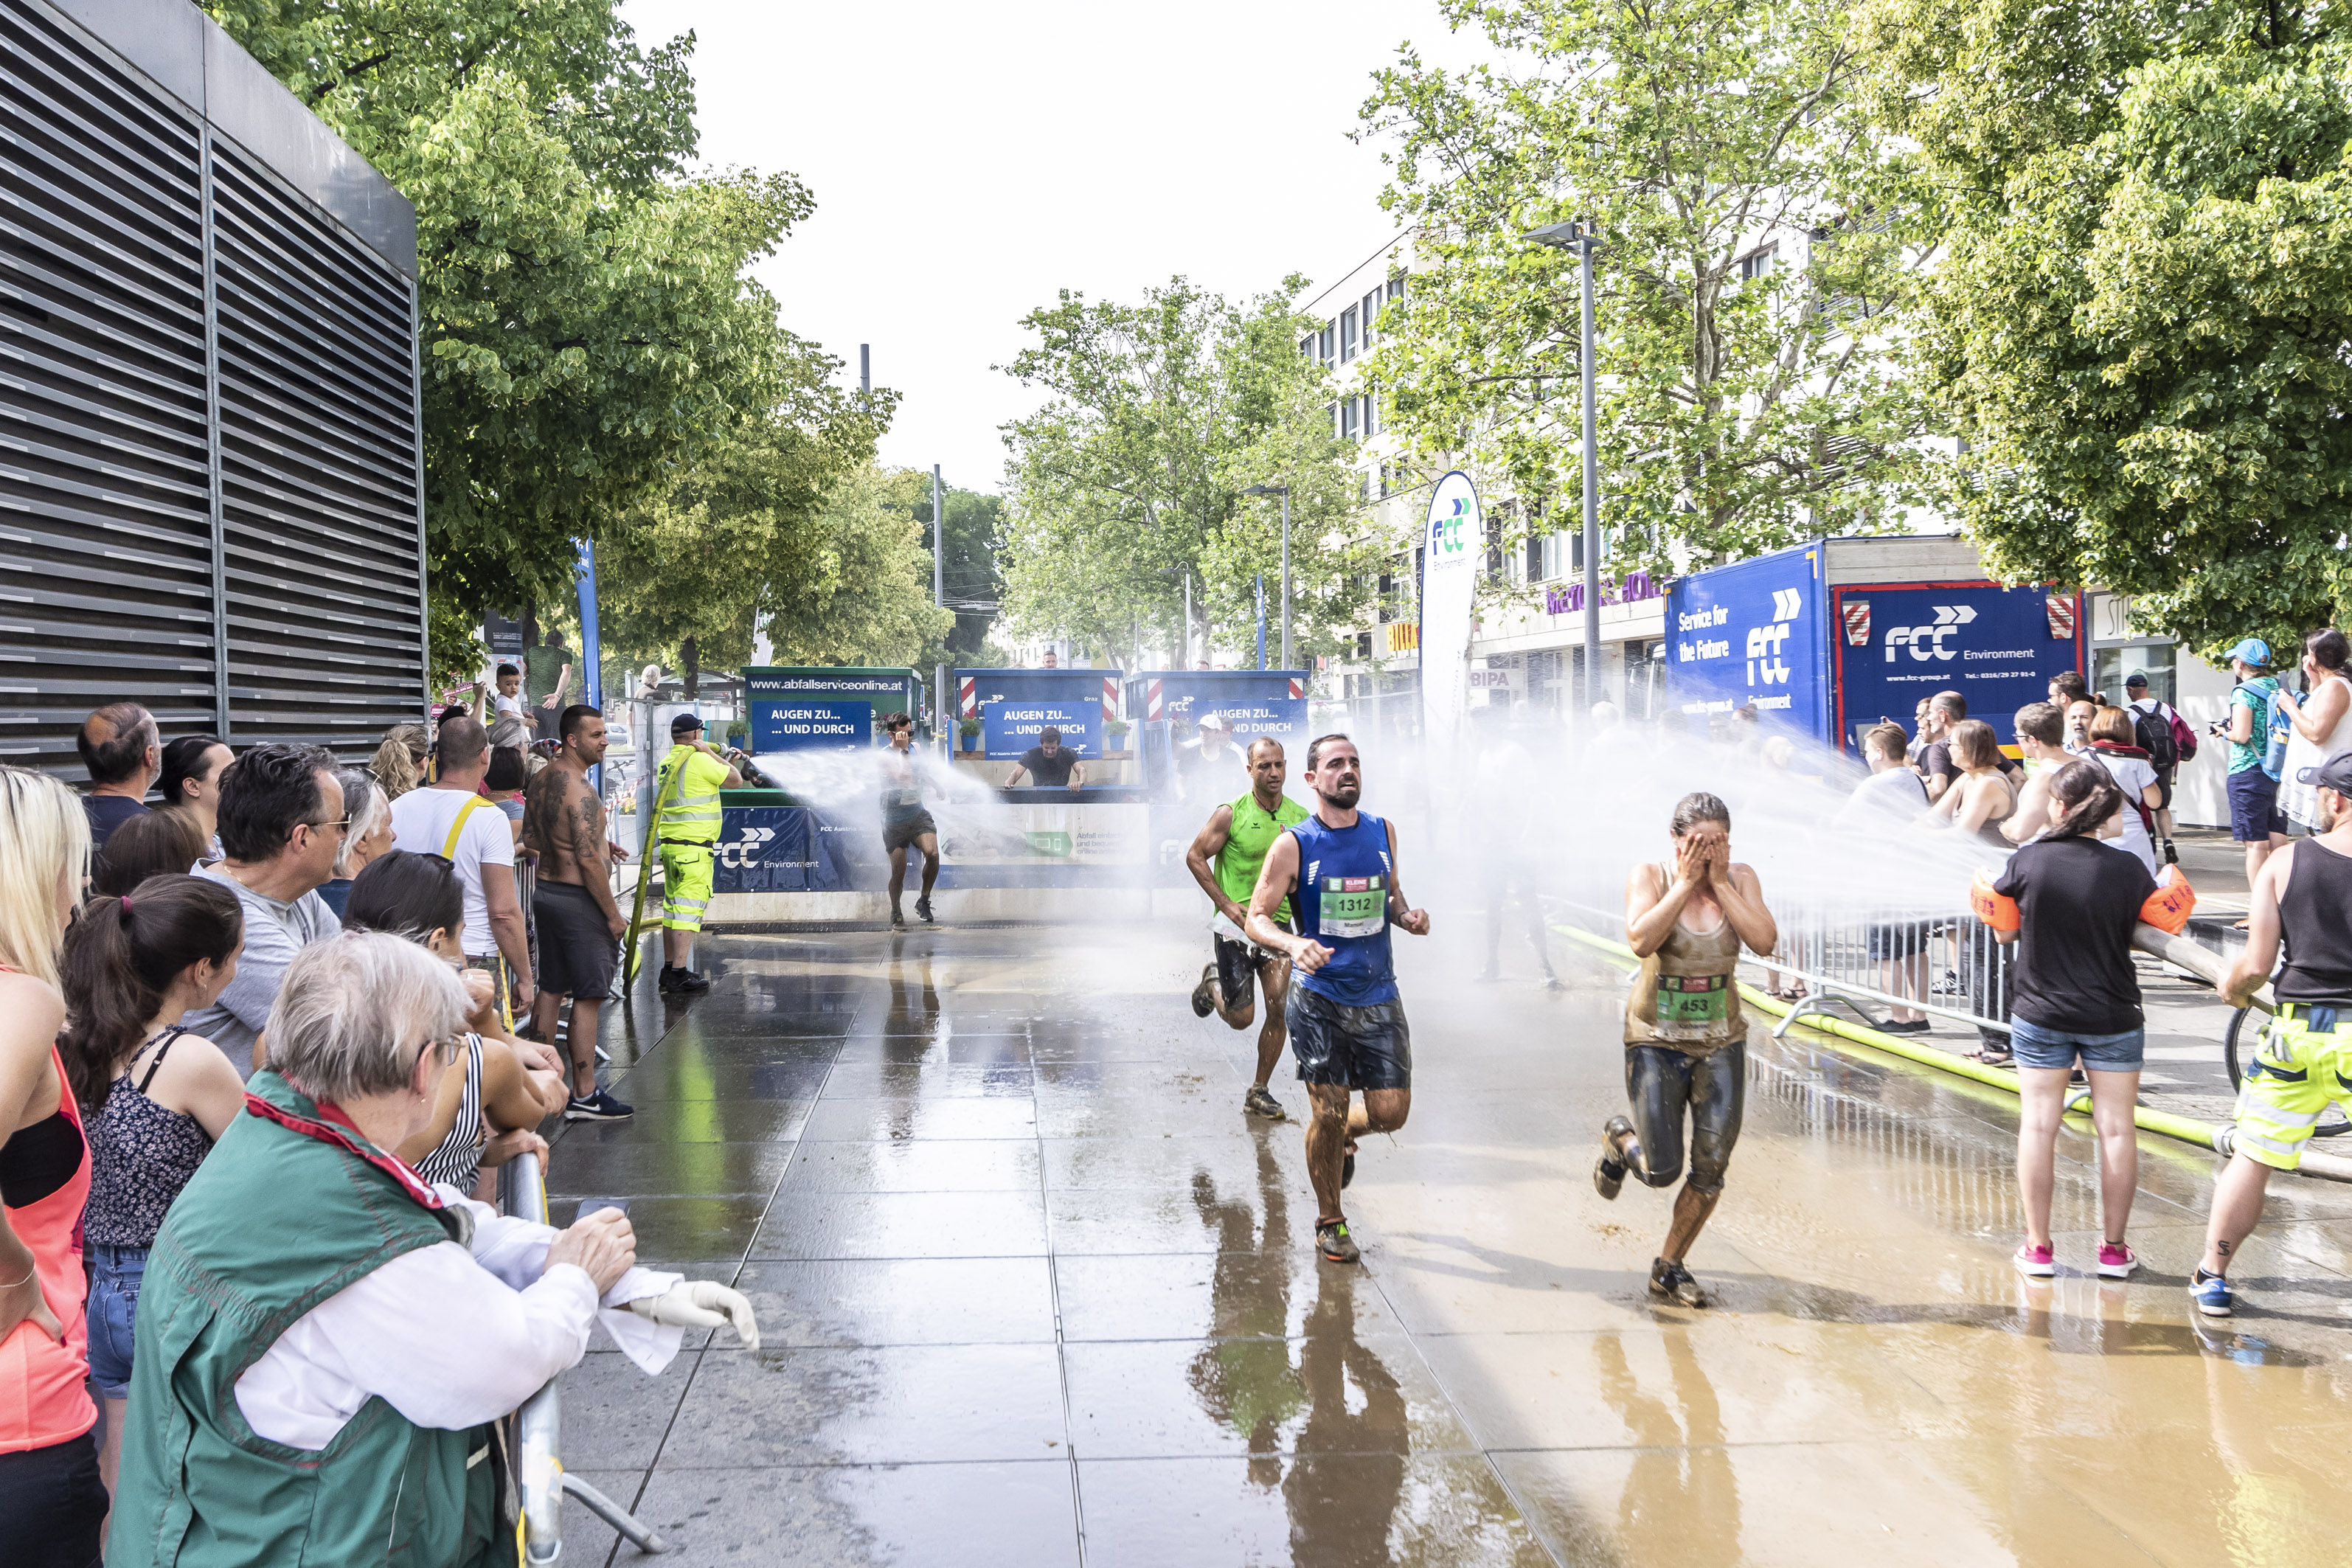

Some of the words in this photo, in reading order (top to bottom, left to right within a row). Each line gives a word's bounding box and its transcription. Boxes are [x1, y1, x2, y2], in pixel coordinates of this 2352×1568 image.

[1433, 517, 1464, 555] FCC
[1679, 608, 1712, 632] Service
[1713, 604, 1728, 625] for
[1387, 623, 1420, 652] BILLA
[1885, 625, 1958, 662] FCC
[1679, 642, 1695, 662] the
[1696, 639, 1730, 660] Future
[1746, 622, 1791, 687] FCC
[1963, 648, 2035, 660] Environment
[1470, 671, 1509, 687] BIPA
[1886, 673, 1951, 682] www.fcc-group.at
[751, 679, 903, 691] www.abfallserviceonline.at
[1168, 701, 1189, 712] FCC
[771, 710, 811, 720] AUGEN
[814, 710, 841, 720] ZU...
[1004, 710, 1044, 721] AUGEN
[1046, 710, 1072, 720] ZU...
[1212, 709, 1250, 719] AUGEN
[1253, 708, 1278, 718] ZU...
[784, 724, 811, 735] UND
[813, 724, 854, 735] DURCH
[1016, 725, 1041, 735] UND
[1044, 724, 1085, 734] URCH
[1252, 722, 1291, 733] DURCH
[764, 860, 819, 869] Environment
[1339, 898, 1371, 912] 1312
[1680, 999, 1708, 1013] 453
